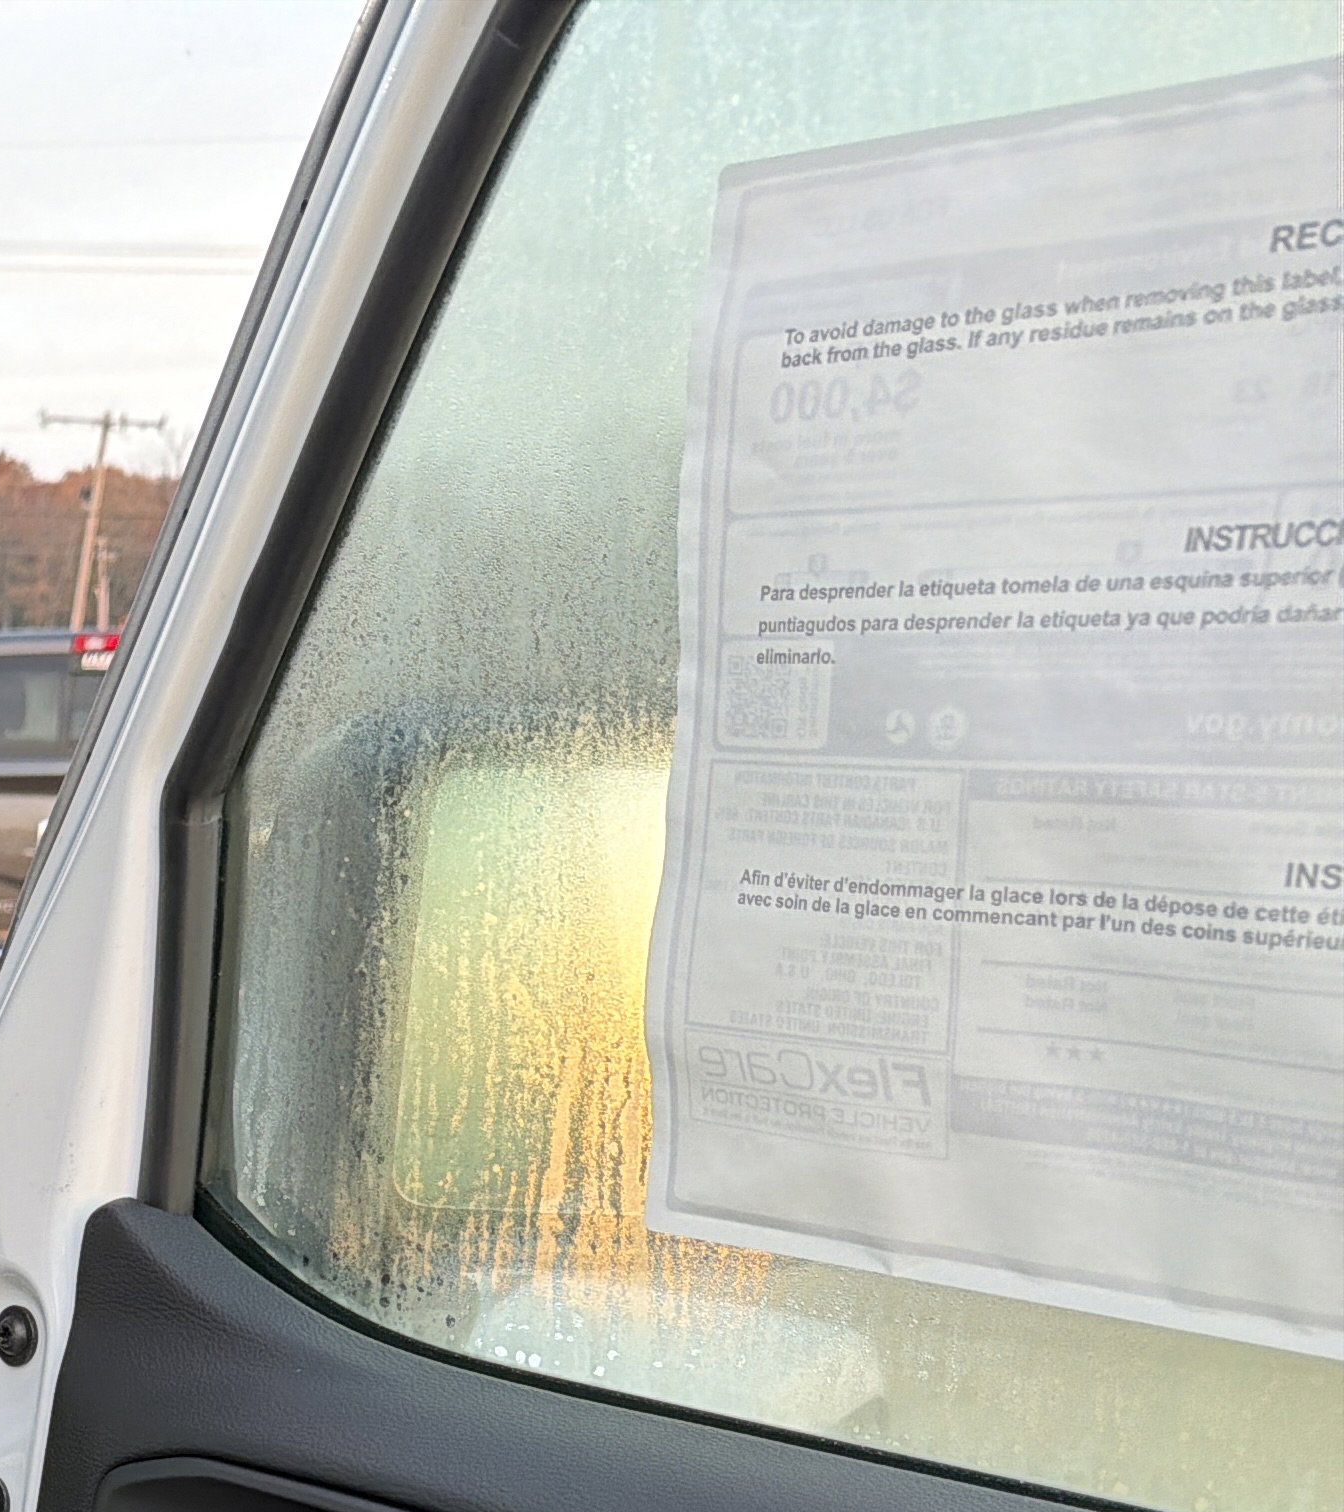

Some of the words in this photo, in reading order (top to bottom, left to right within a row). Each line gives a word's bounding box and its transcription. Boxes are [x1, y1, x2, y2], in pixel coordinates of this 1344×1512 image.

[781, 348, 822, 369] back
[827, 345, 869, 365] from
[873, 340, 902, 360] the
[906, 336, 962, 360] glass.
[968, 330, 982, 349] If
[985, 329, 1024, 350] any
[1029, 320, 1108, 344] residue
[1113, 310, 1197, 335] remains
[1203, 306, 1233, 325] on
[1239, 300, 1277, 321] the
[784, 328, 804, 346] To
[809, 321, 858, 343] avoid
[862, 314, 936, 337] damage
[940, 311, 960, 328] to
[964, 306, 996, 325] the
[1001, 301, 1058, 326] glass
[1065, 295, 1120, 316] when
[1125, 281, 1226, 310] removing
[1233, 273, 1276, 297] this
[760, 584, 795, 602] Para
[799, 581, 895, 604] desprender
[899, 579, 914, 598] la
[919, 577, 995, 600] etiqueta
[1075, 575, 1101, 594] de
[1106, 575, 1144, 593] una
[1149, 570, 1233, 594] esquina
[758, 615, 856, 637] puntiagudos
[861, 617, 899, 636] para
[903, 613, 1013, 635] desprender
[1017, 611, 1035, 629] la
[1040, 610, 1121, 632] etiqueta
[1126, 612, 1151, 632] ya
[1157, 611, 1195, 633] que
[756, 648, 836, 667] eliminarlo.
[737, 891, 772, 908] avec
[775, 894, 808, 912] soin
[811, 895, 831, 913] de
[836, 897, 850, 915] la
[854, 899, 900, 921] glace
[905, 906, 927, 921] en
[1062, 914, 1096, 933] par
[1099, 913, 1135, 934] l'un
[1140, 917, 1177, 937] des
[1182, 923, 1237, 943] coins
[740, 868, 770, 887] Afin
[774, 871, 830, 892] d'éviter
[834, 876, 964, 903] d'endommager
[969, 884, 985, 902] la
[991, 886, 1044, 907] glace
[1049, 888, 1087, 908] lors
[1093, 891, 1117, 909] de
[1122, 893, 1139, 911] la
[1144, 894, 1217, 918] dépose
[1223, 901, 1249, 920] de
[1254, 905, 1311, 925] cette
